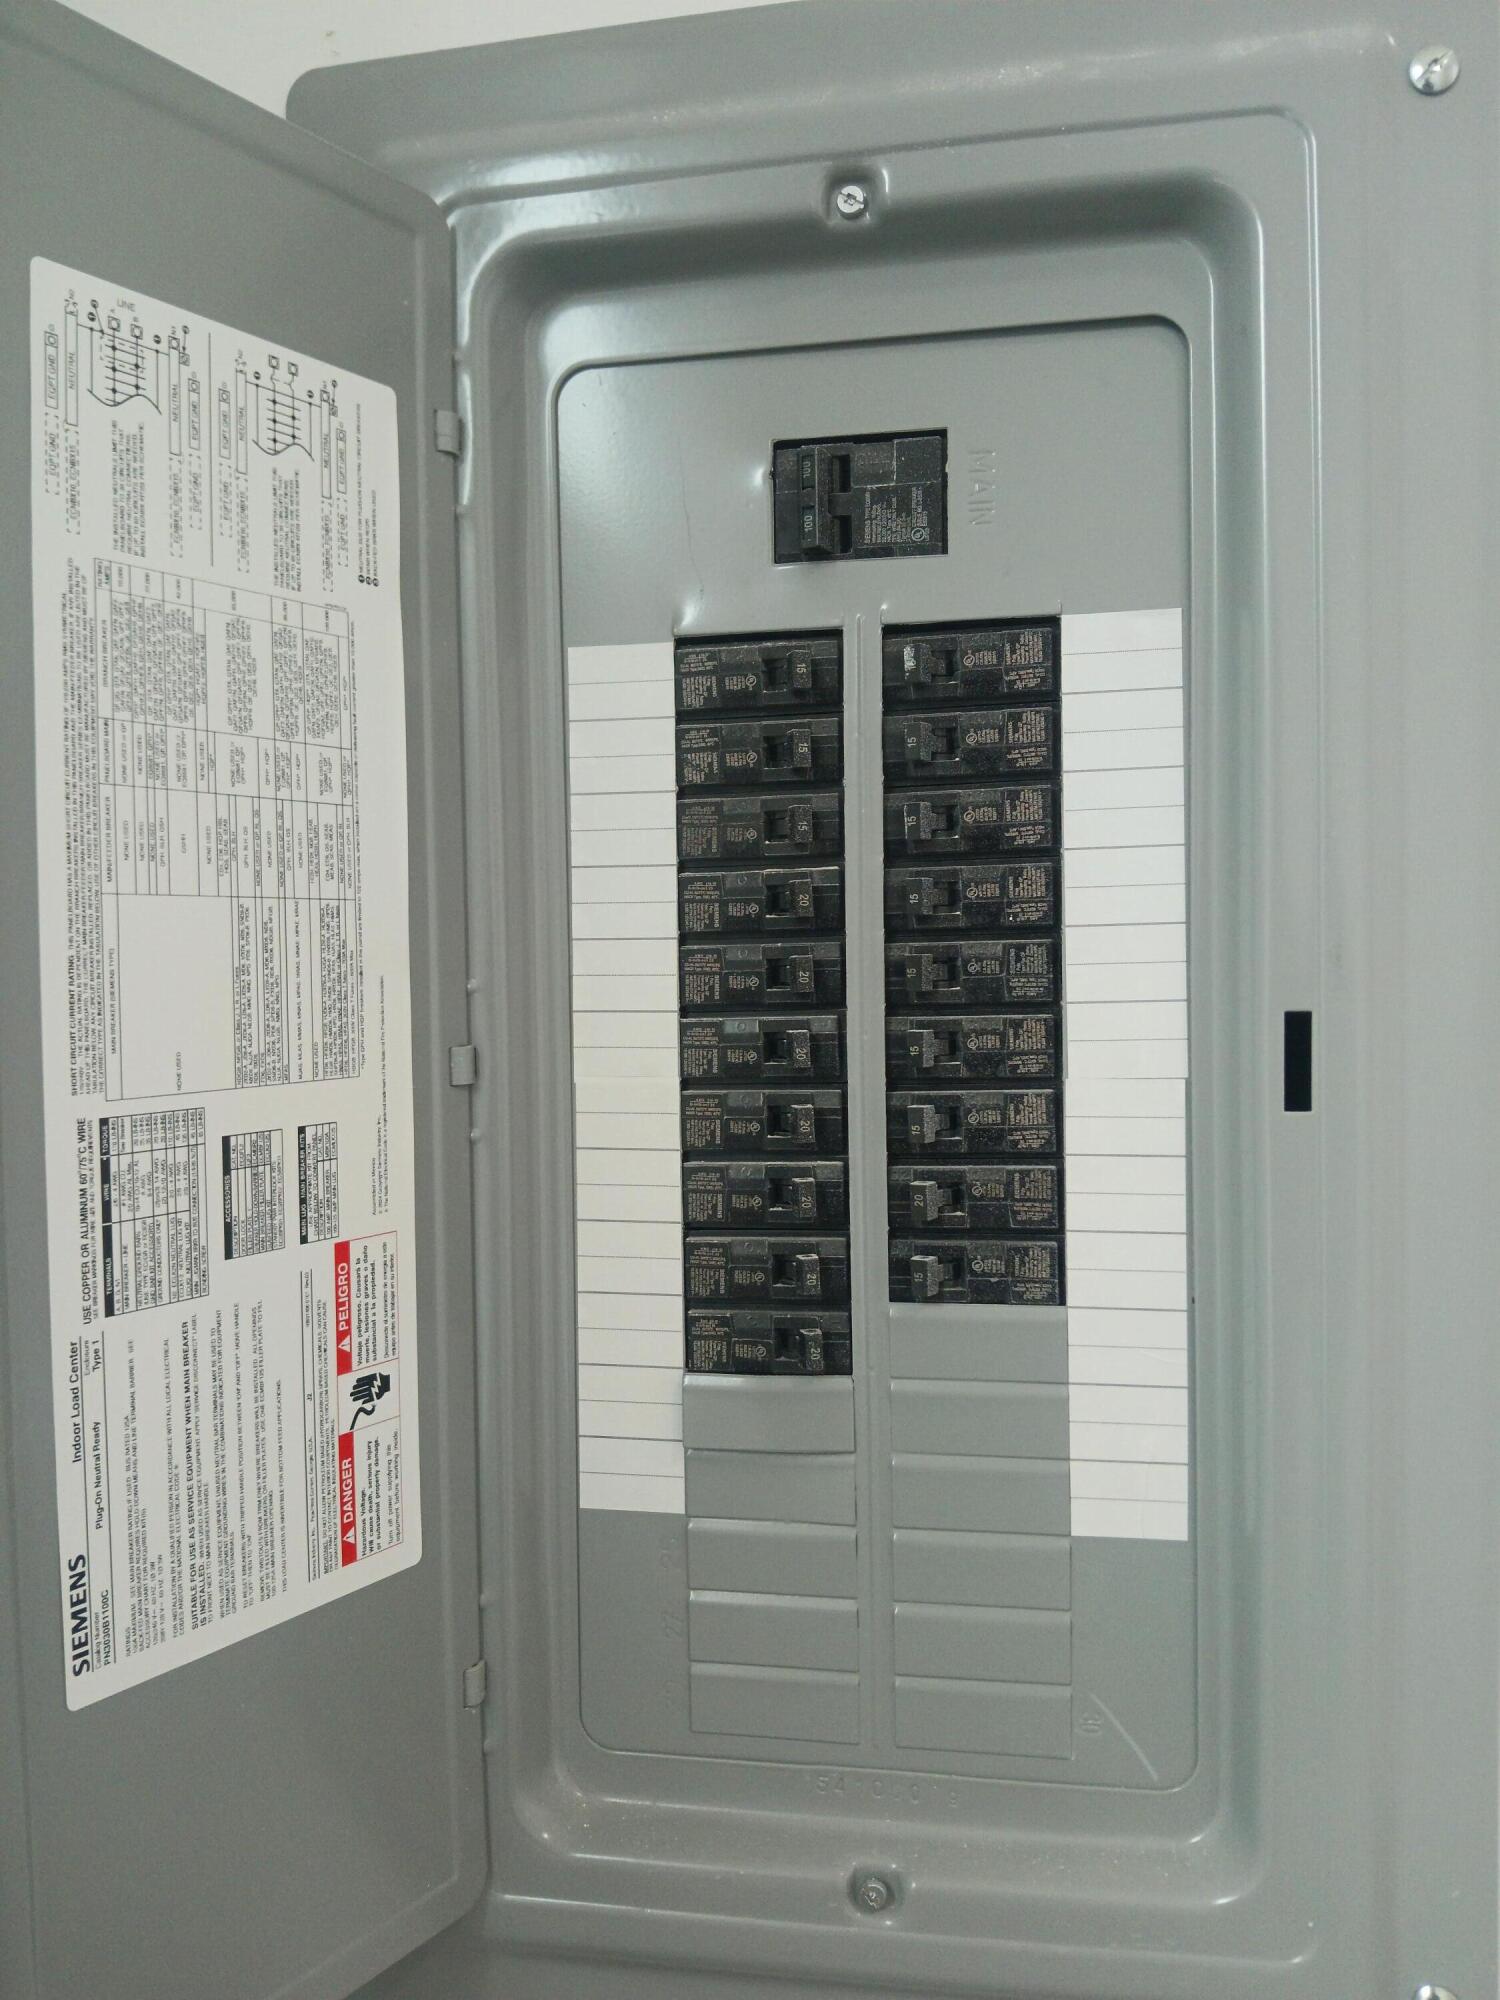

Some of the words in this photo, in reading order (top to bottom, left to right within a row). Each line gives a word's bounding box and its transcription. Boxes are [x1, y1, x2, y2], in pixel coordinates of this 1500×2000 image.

[47, 354, 55, 374] GND
[48, 377, 56, 399] EQPT
[49, 453, 57, 476] EQPT
[803, 461, 811, 478] 100
[968, 450, 996, 526] MAIN
[192, 491, 200, 512] EQPT
[805, 515, 813, 531] 100
[797, 664, 806, 675] 15
[799, 742, 808, 753] 15
[907, 737, 916, 747] 15
[798, 821, 807, 832] 15
[907, 816, 916, 826] 15
[799, 895, 809, 907] 20
[910, 893, 918, 904] 15
[799, 971, 809, 983] 20
[907, 968, 916, 979] 15
[797, 1048, 806, 1060] 20
[910, 1045, 919, 1056] 15
[77, 1118, 85, 1143] WIRE
[801, 1120, 810, 1132] 20
[912, 1125, 920, 1135] 15
[802, 1196, 811, 1208] 20
[914, 1194, 923, 1207] 20
[79, 1187, 88, 1239] ALUMINUM
[80, 1243, 89, 1258] OR
[355, 1257, 360, 1265] la
[81, 1261, 91, 1301] COPPER
[807, 1273, 816, 1286] 20
[914, 1271, 923, 1283] 15
[337, 1262, 348, 1330] PELIGRO
[82, 1304, 91, 1324] USE
[92, 1348, 101, 1372] Type
[811, 1347, 820, 1360] 20
[69, 1342, 78, 1383] Center
[70, 1386, 80, 1418] Load
[72, 1422, 81, 1462] Indoor
[92, 1421, 100, 1451] Ready
[185, 1427, 193, 1481] EQUIPMENT
[93, 1453, 101, 1488] Neutral
[342, 1458, 353, 1522] DANGER
[94, 1490, 104, 1529] Plug-On
[188, 1526, 195, 1539] AS
[170, 1566, 176, 1574] BY
[198, 1562, 206, 1615] INSTALLED.
[190, 1584, 198, 1629] SUITABLE
[68, 1555, 89, 1675] SIEMENS
[200, 1616, 206, 1626] IS
